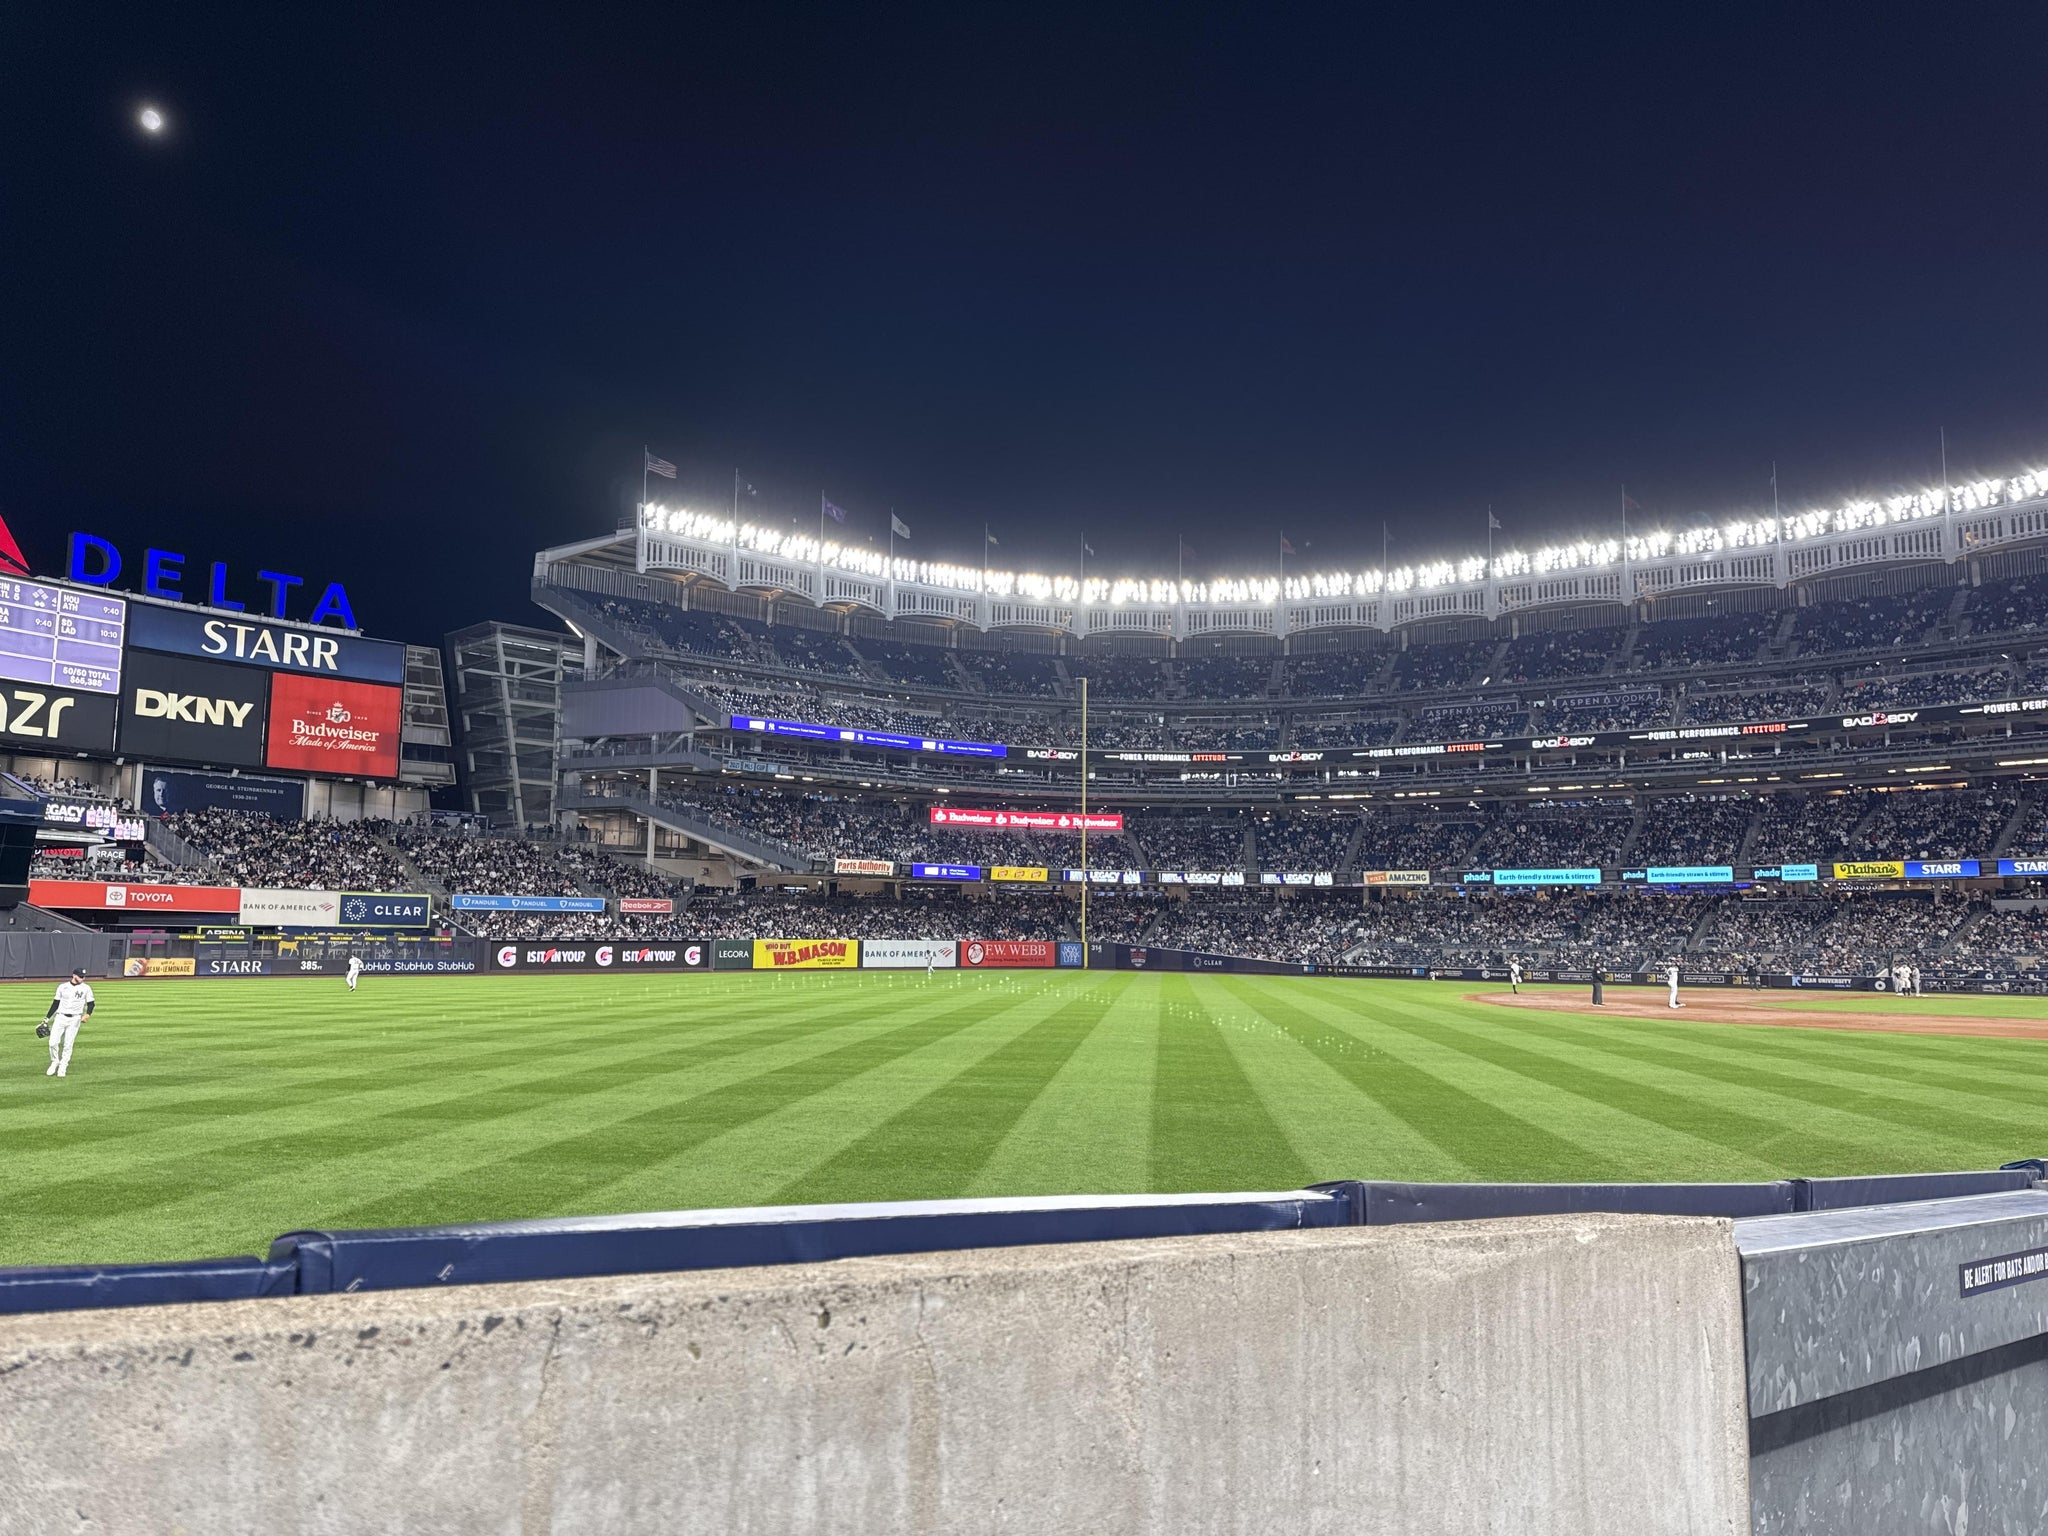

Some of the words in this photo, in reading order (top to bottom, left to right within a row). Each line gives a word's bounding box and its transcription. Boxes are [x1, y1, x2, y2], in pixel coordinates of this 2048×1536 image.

[66, 531, 357, 629] DELTA
[63, 594, 80, 604] HOU
[63, 602, 79, 612] ATH
[103, 606, 120, 616] 9:40
[35, 618, 53, 628] 9:40
[61, 618, 73, 627] SD
[60, 626, 77, 636] LAD
[100, 629, 118, 639] 10:10
[201, 619, 339, 670] STARR
[62, 666, 87, 677] 50/50
[88, 669, 111, 681] TOTAL
[1561, 697, 1600, 707] ASPEN
[1613, 692, 1654, 703] VODKA
[135, 688, 254, 728] DKNY
[1475, 704, 1512, 714] VODKA
[1983, 703, 2021, 714] POWER.
[325, 708, 351, 724] 150
[1842, 717, 1873, 728] BAD
[1887, 712, 1919, 723] BOY
[291, 719, 379, 742] Budweiser
[1648, 730, 1678, 740] POWER.
[1679, 726, 1741, 739] PERFORMANCE.
[289, 735, 323, 747] Made
[323, 740, 336, 750] of
[333, 740, 377, 752] America
[1531, 739, 1557, 749] BAD
[1570, 736, 1595, 747] BOY
[1027, 750, 1048, 759] BAD
[1058, 751, 1078, 760] BOY
[1119, 753, 1143, 761] POWER.
[1144, 753, 1191, 762] PERFORMANCE.
[1268, 753, 1291, 762] BAD
[1302, 752, 1324, 761] BOY
[1369, 748, 1394, 758] POWER.
[1395, 746, 1446, 757] PERFORMANCE.
[205, 783, 228, 791] GEORGE
[237, 785, 277, 795] STEINBRENNER
[949, 812, 992, 824] Budweiser
[1010, 814, 1055, 826] Budweiser
[44, 848, 83, 857] TOYOTA
[838, 861, 856, 870] Parts
[857, 860, 891, 872] Authority
[1840, 863, 1899, 876] Nathan's
[1921, 863, 1962, 875] STARR
[2013, 861, 2048, 873] STAR
[1389, 873, 1427, 882] AMAZING
[1463, 872, 1492, 884] phade
[1499, 873, 1542, 883] Earth-friendly
[1571, 872, 1596, 880] stirrers
[1623, 871, 1645, 880] phade
[1651, 871, 1686, 879] Earth-friendly
[1754, 868, 1781, 880] phade
[130, 891, 174, 903] TOYOTA
[280, 903, 317, 912] AMERICA
[471, 899, 500, 907] FANDUEL
[520, 900, 548, 908] FANDUEL
[622, 901, 652, 910] Reebok
[374, 905, 422, 917] CLEAR
[765, 943, 779, 951] WHO
[985, 944, 1006, 956] F.W.
[1009, 944, 1047, 956] WEBB
[562, 950, 586, 963] YOU?
[654, 950, 677, 962] YOU?
[719, 950, 749, 959] LEGORA
[865, 951, 886, 959] BANK
[901, 951, 937, 959] AMERIA
[1063, 955, 1079, 963] LIFE
[163, 965, 190, 973] LEMONADE
[210, 960, 262, 973] STARR
[300, 961, 318, 971] 385
[394, 961, 434, 971] StubHub
[437, 961, 475, 971] StubHub
[1964, 1268, 1974, 1290] BE
[1974, 1264, 1994, 1287] ALERT
[1994, 1261, 2006, 1282] FOR
[2006, 1258, 2022, 1279] BATS
[2023, 1253, 2044, 1275] AND/OR
